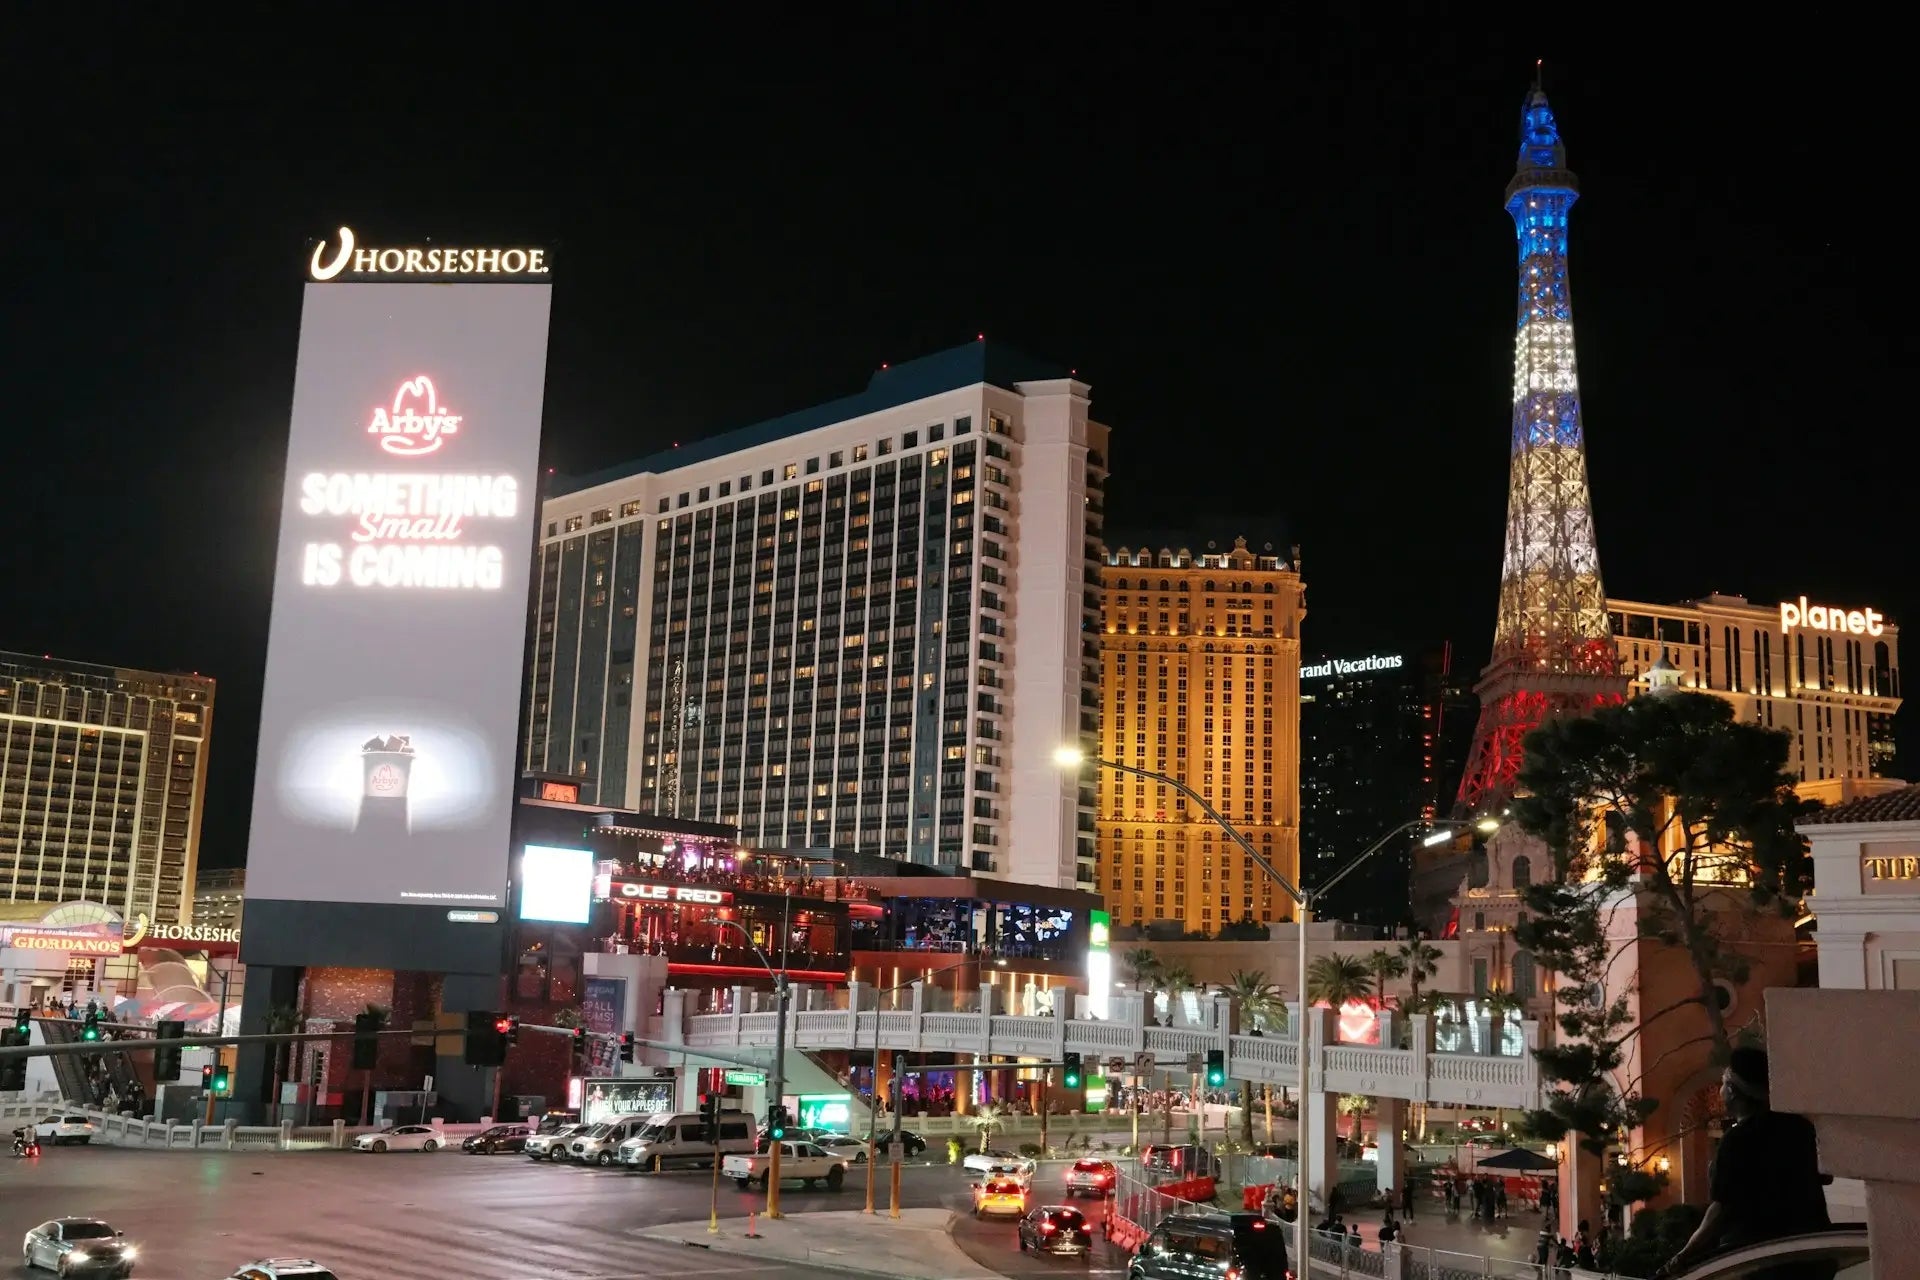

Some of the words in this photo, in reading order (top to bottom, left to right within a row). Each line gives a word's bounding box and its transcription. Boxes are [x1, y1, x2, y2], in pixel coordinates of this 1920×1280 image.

[368, 407, 462, 440] Arby's
[301, 472, 517, 517] SOMETHING
[352, 511, 461, 542] Small
[303, 543, 342, 585] IS
[350, 544, 502, 588] COMING
[1780, 595, 1884, 637] planet
[1333, 654, 1403, 674] Vacations
[1864, 856, 1920, 880] TIF
[621, 883, 670, 899] OLE
[676, 887, 722, 903] RED
[614, 1100, 631, 1111] YOUR
[632, 1100, 655, 1111] APPLES
[656, 1100, 668, 1112] OFF
